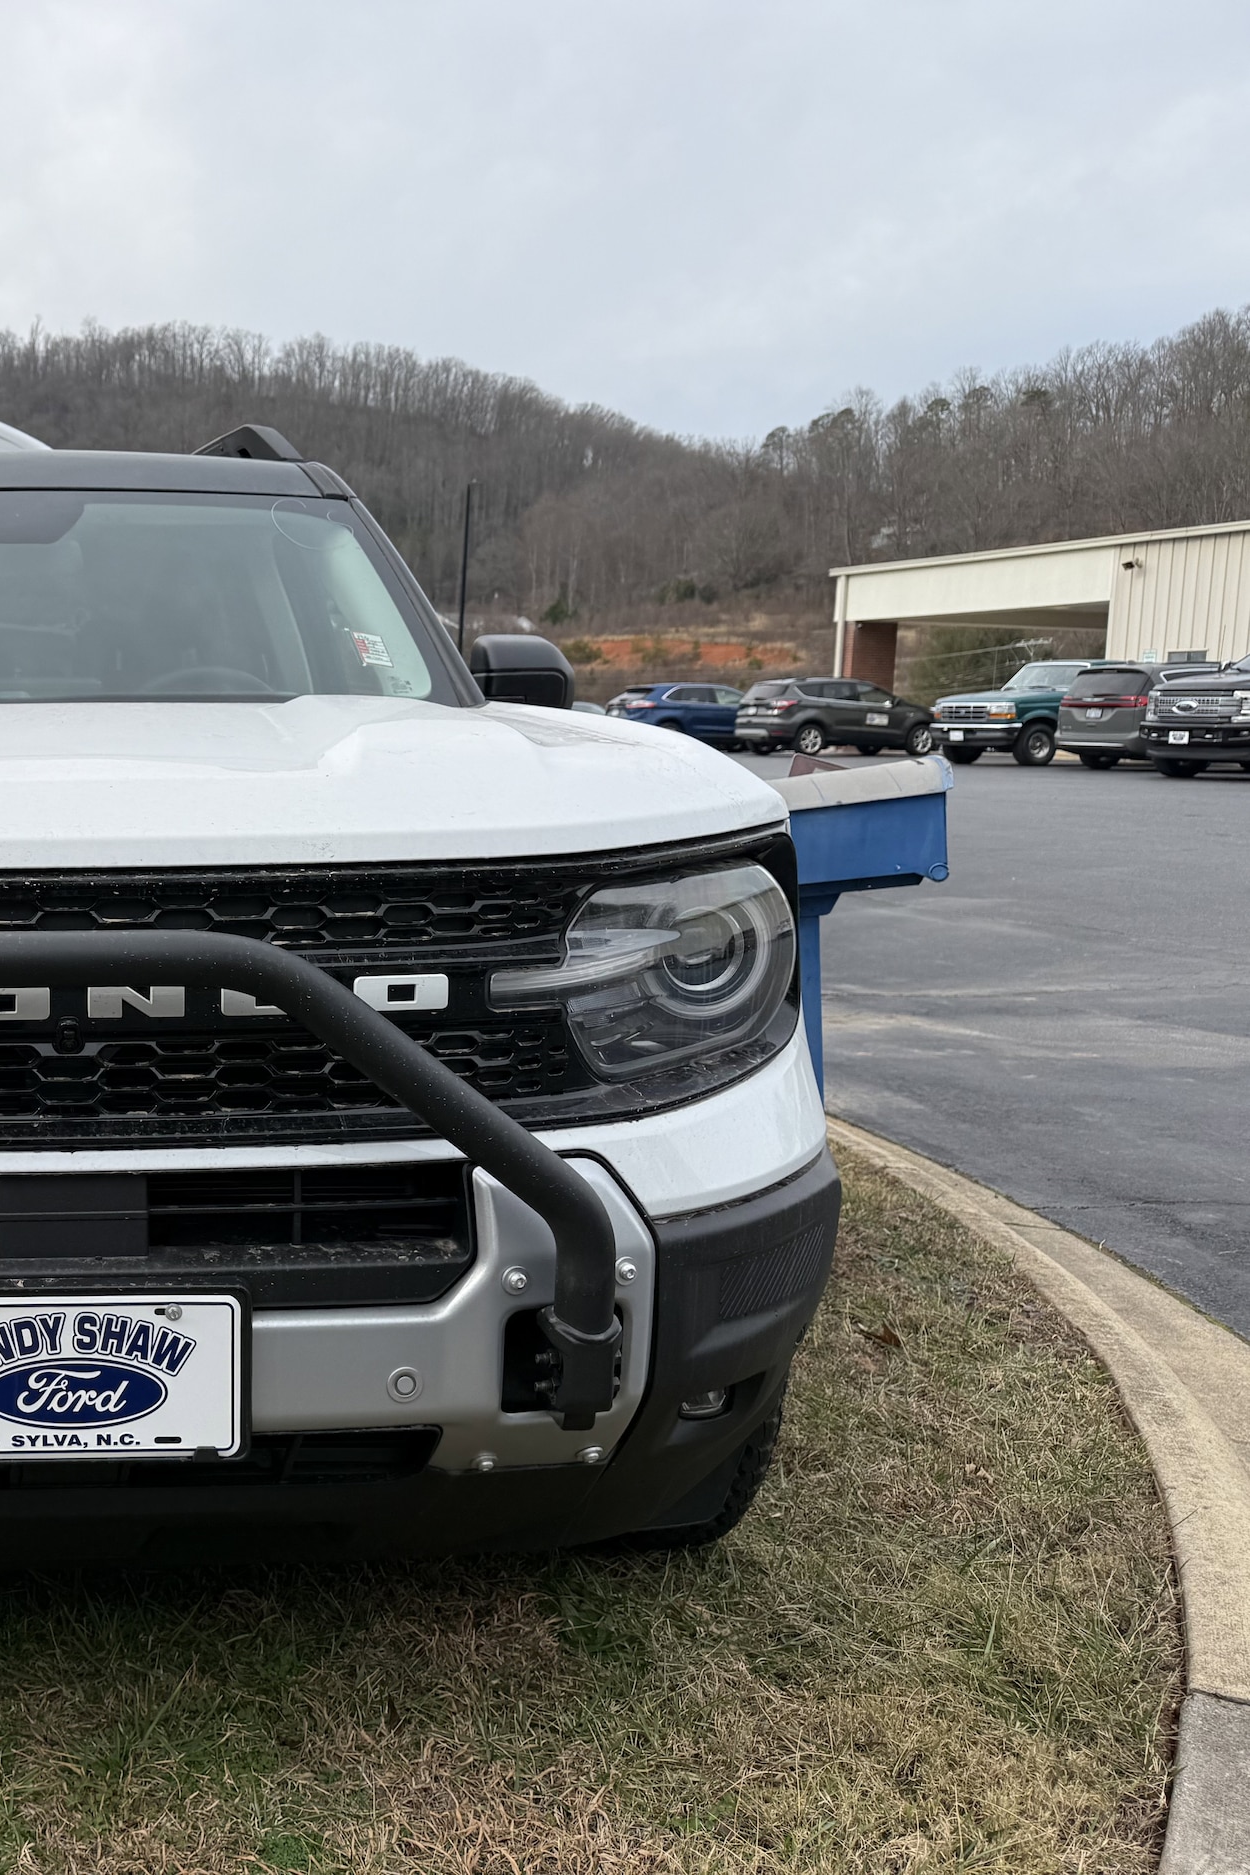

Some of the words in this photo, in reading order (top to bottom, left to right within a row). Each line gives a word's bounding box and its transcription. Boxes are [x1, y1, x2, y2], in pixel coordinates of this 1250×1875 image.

[73, 1312, 196, 1376] SHAW
[16, 1368, 130, 1413] Ford
[11, 1434, 88, 1449] SYLVA,
[96, 1433, 141, 1447] N.C.
